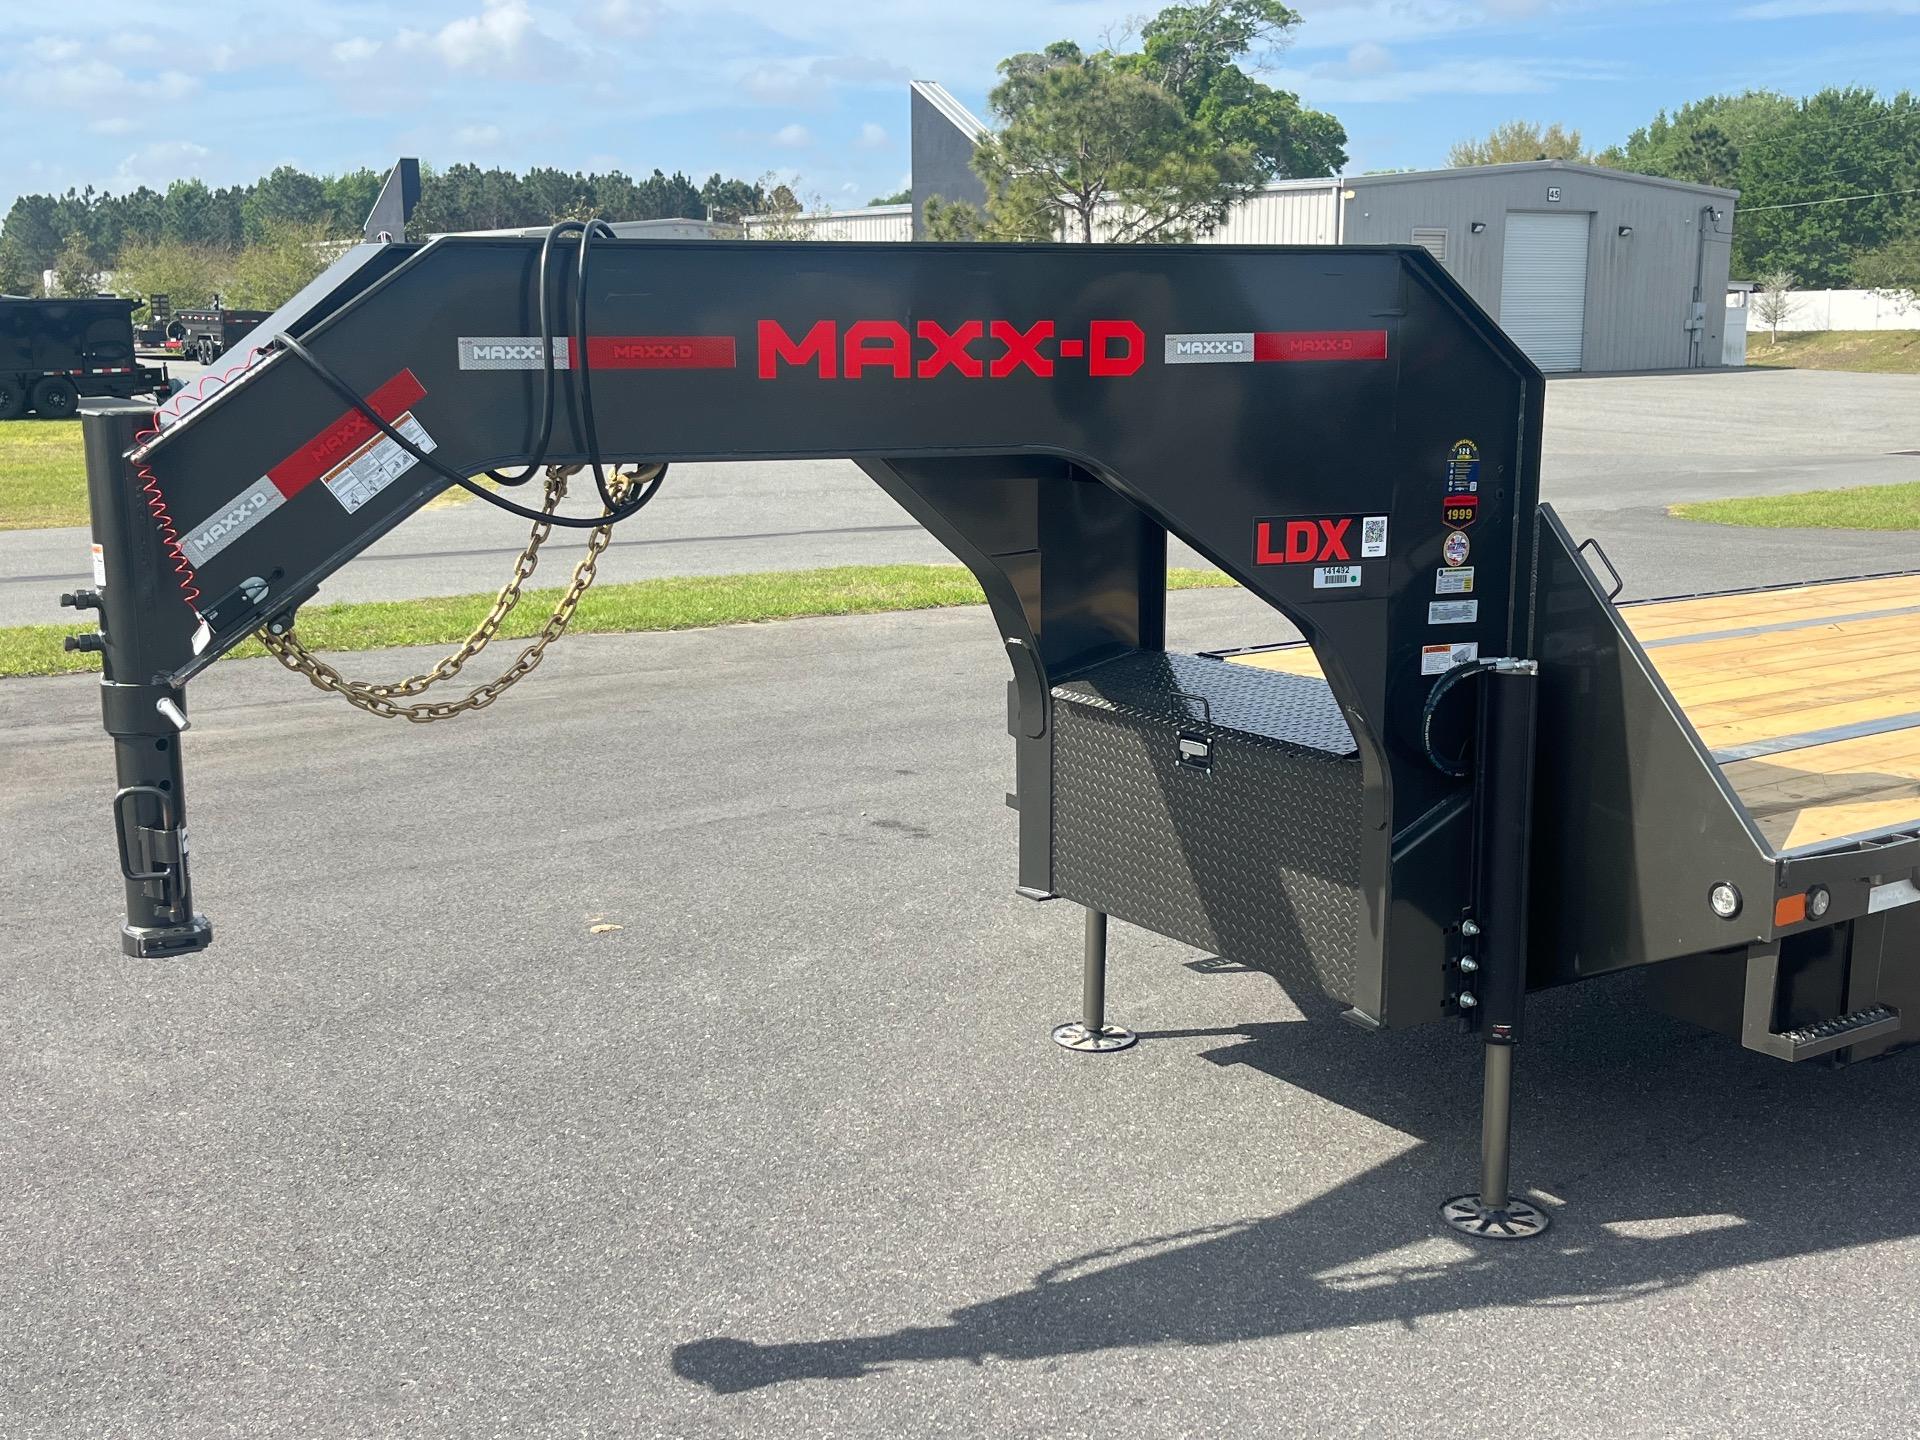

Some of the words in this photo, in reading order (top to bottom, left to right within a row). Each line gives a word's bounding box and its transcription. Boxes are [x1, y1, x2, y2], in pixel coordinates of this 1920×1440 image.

[1549, 190, 1559, 198] 45
[613, 345, 693, 359] MAXX-D
[757, 319, 1145, 379] MAXX-D
[1177, 341, 1243, 354] MAXX-D
[1290, 338, 1353, 352] MAXX-D
[473, 345, 556, 360] MAXX-
[1447, 508, 1473, 520] 1999
[194, 492, 267, 552] MAXX-D
[1257, 518, 1352, 564] LDX
